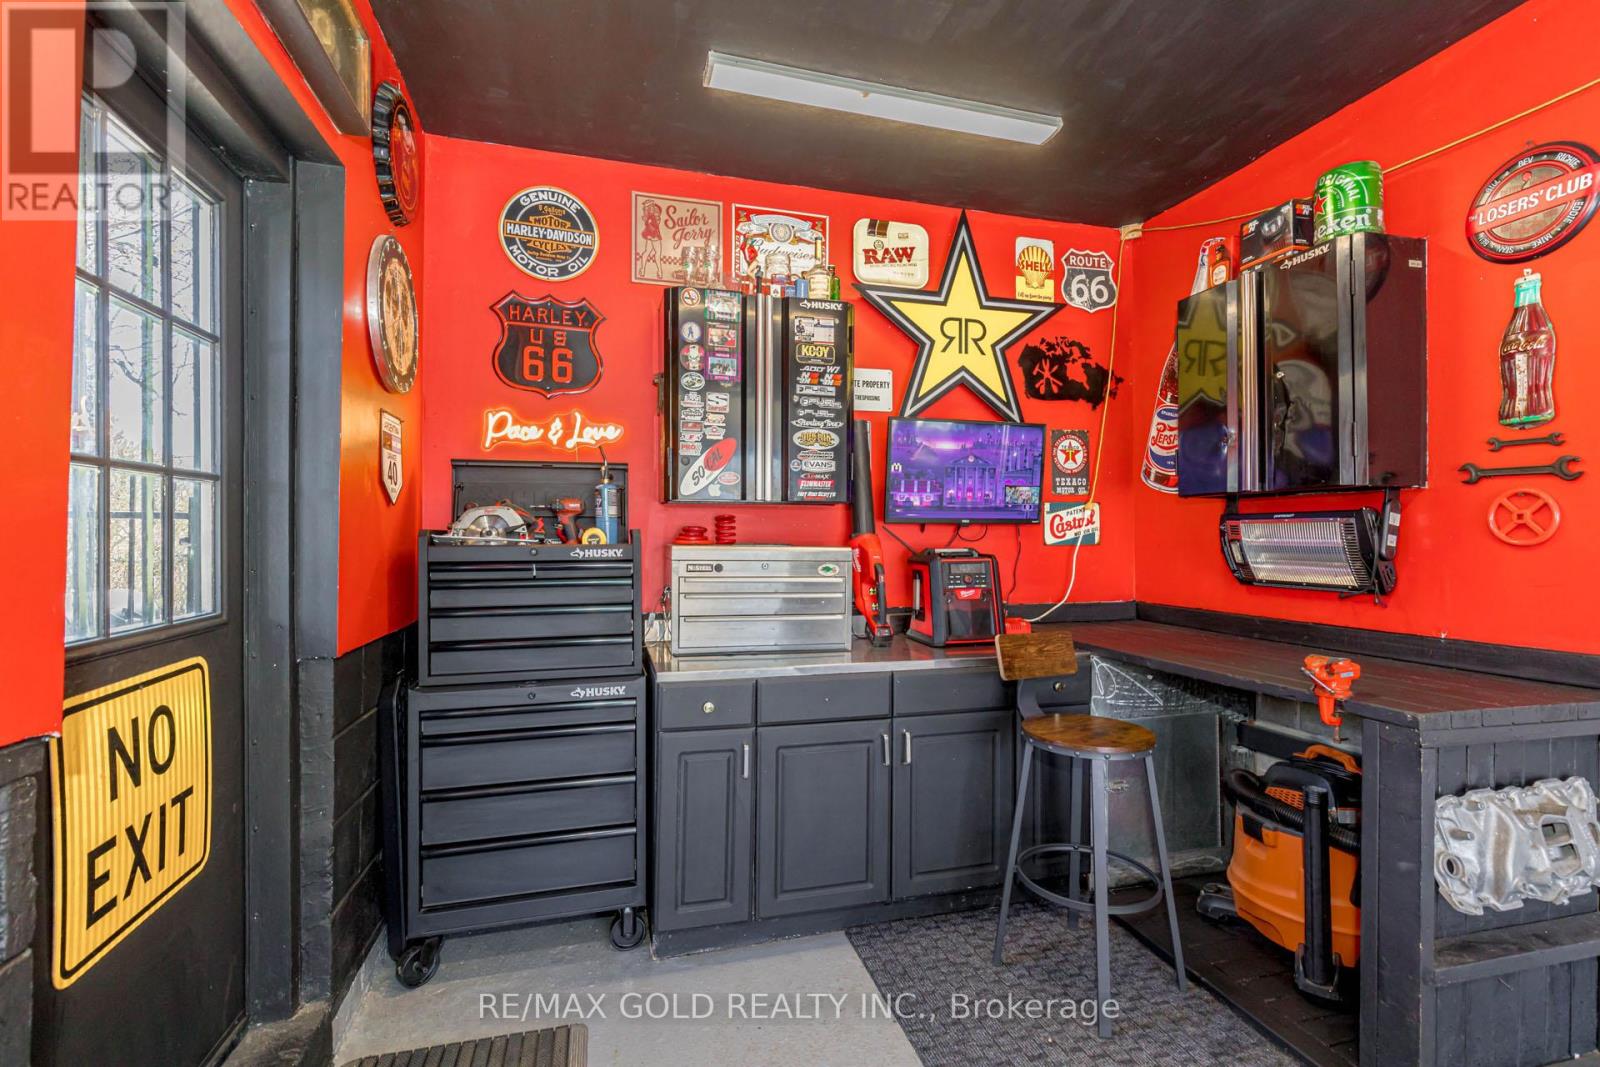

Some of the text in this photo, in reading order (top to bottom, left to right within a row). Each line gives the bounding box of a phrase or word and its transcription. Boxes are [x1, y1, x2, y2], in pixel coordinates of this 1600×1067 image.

[520, 191, 580, 213] GENUINE
[1478, 172, 1593, 226] LOSERS' CLUB
[533, 216, 568, 229] MOTOR
[664, 205, 710, 230] Sailor
[1314, 207, 1372, 242] eken
[672, 225, 716, 250] Jerry
[508, 244, 589, 277] MOTOR OIL
[862, 246, 916, 265] RAW
[1019, 259, 1050, 273] SHELL
[1069, 255, 1107, 268] ROUTE
[1292, 243, 1330, 266] HUSKY
[1071, 274, 1109, 304] 66
[508, 304, 588, 327] HARLEY
[811, 301, 843, 311] HUSKY
[522, 345, 574, 384] 66
[862, 379, 891, 389] PROPERTY
[547, 416, 563, 445] &
[565, 411, 622, 449] Love
[387, 459, 398, 487] 40
[692, 465, 705, 486] SO
[1055, 477, 1087, 486] TEXACO
[585, 548, 623, 558] HUSKY
[585, 686, 626, 698] HUSKY
[107, 704, 176, 802] NO
[86, 785, 194, 930] EXIT
